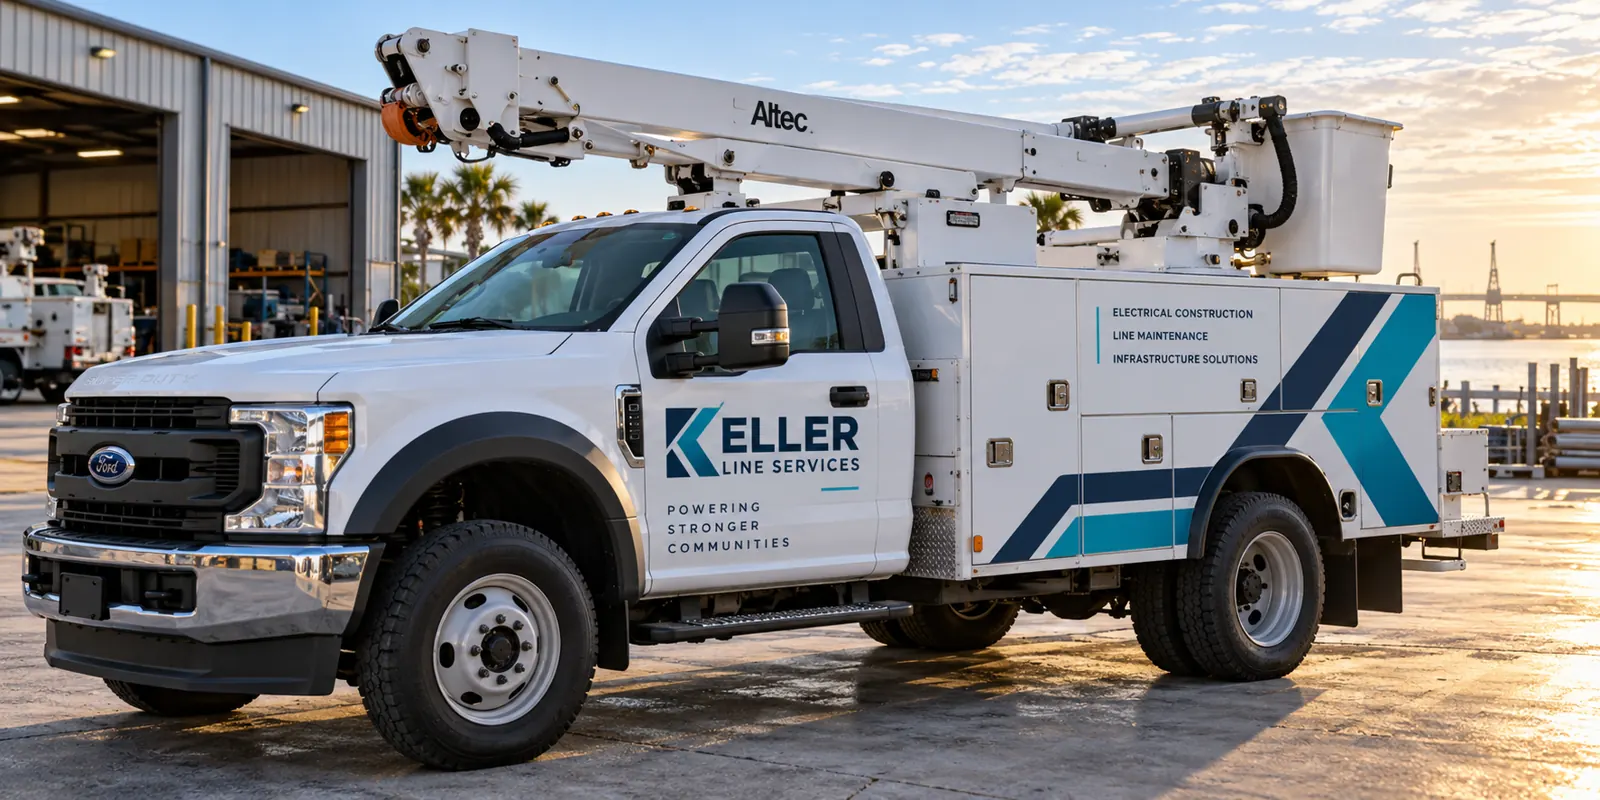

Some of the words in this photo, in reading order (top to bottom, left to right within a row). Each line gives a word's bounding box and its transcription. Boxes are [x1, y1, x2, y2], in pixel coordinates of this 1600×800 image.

[751, 100, 808, 133] Altec
[1112, 307, 1173, 318] ELECTRICAL
[1174, 308, 1254, 319] CONSTRUCTION
[1112, 330, 1135, 341] LINE
[1137, 331, 1209, 342] MAINTENANCE
[1113, 353, 1201, 364] INFRASTRUCTURE
[1202, 354, 1259, 365] SOLUTIONS
[140, 373, 199, 386] DUTY
[665, 401, 860, 479] KELLER
[96, 454, 119, 474] Ford
[722, 460, 764, 476] LINE
[772, 457, 860, 475] SERVICES
[667, 501, 760, 516] POWERING
[667, 520, 759, 535] STRONGER
[667, 537, 790, 554] COMMUNITIES
